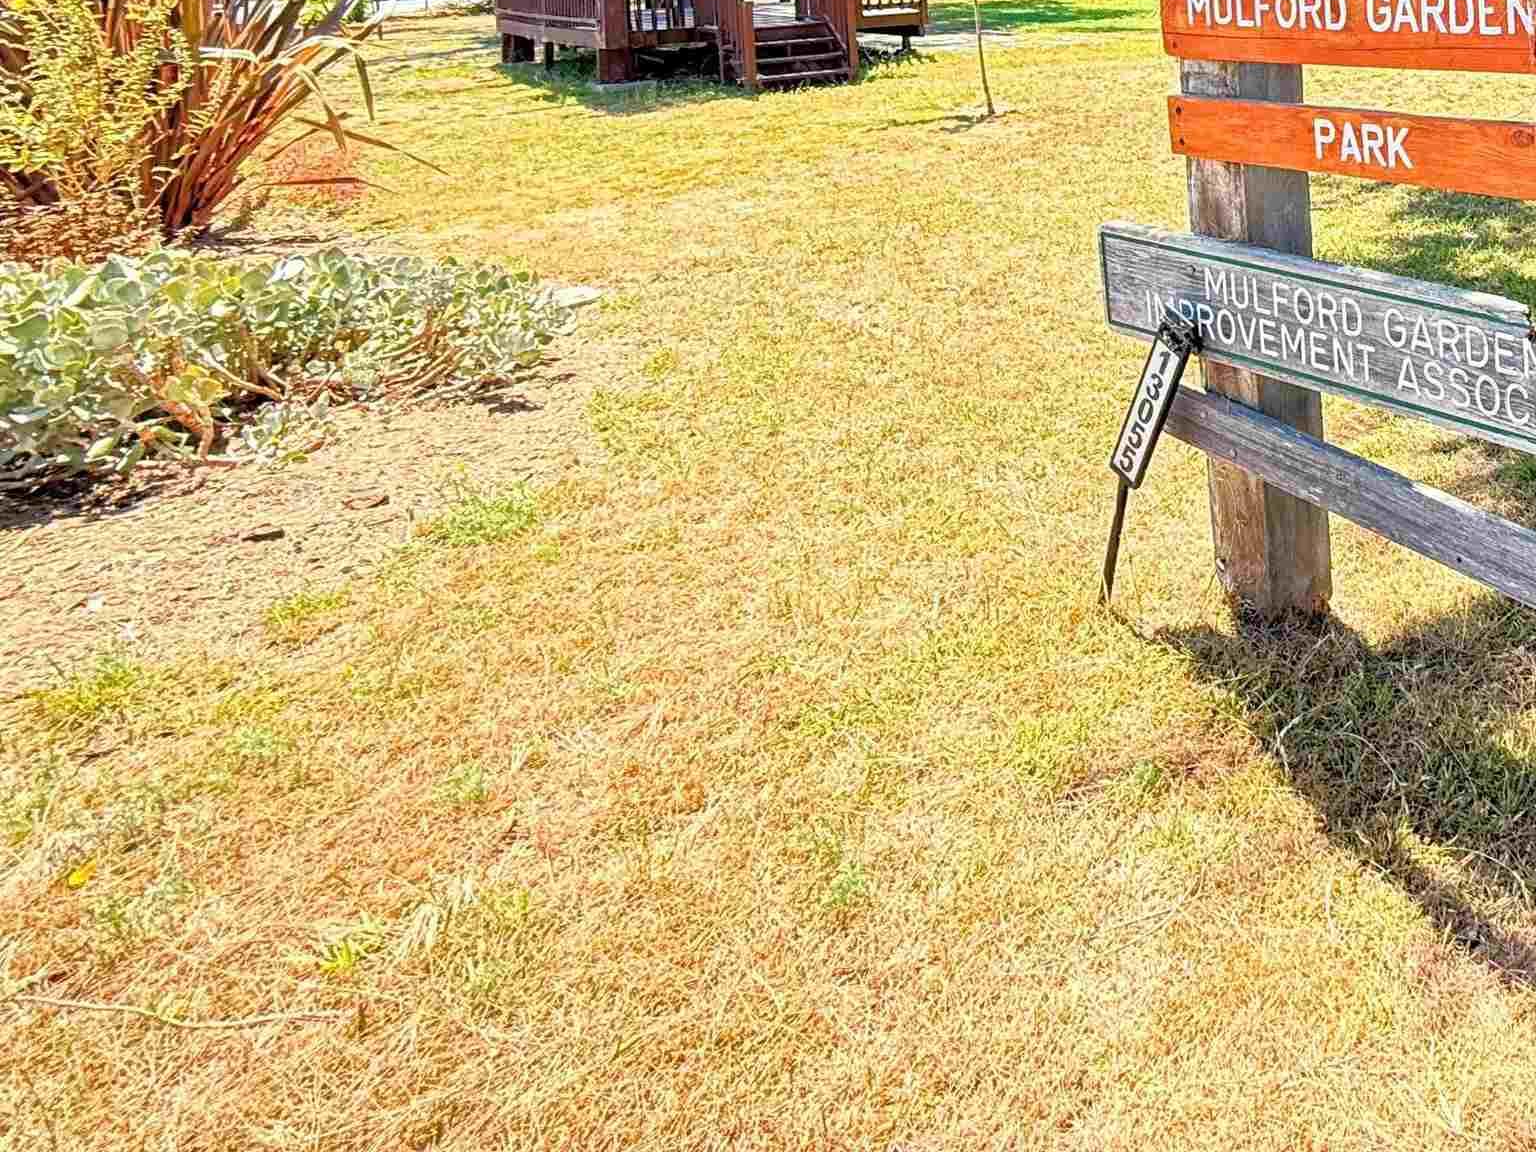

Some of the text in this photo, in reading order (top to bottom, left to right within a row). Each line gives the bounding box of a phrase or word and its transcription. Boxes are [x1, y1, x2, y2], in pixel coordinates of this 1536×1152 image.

[1312, 117, 1416, 170] PARK
[1203, 267, 1363, 337] MULFORD
[1119, 350, 1172, 472] 13055
